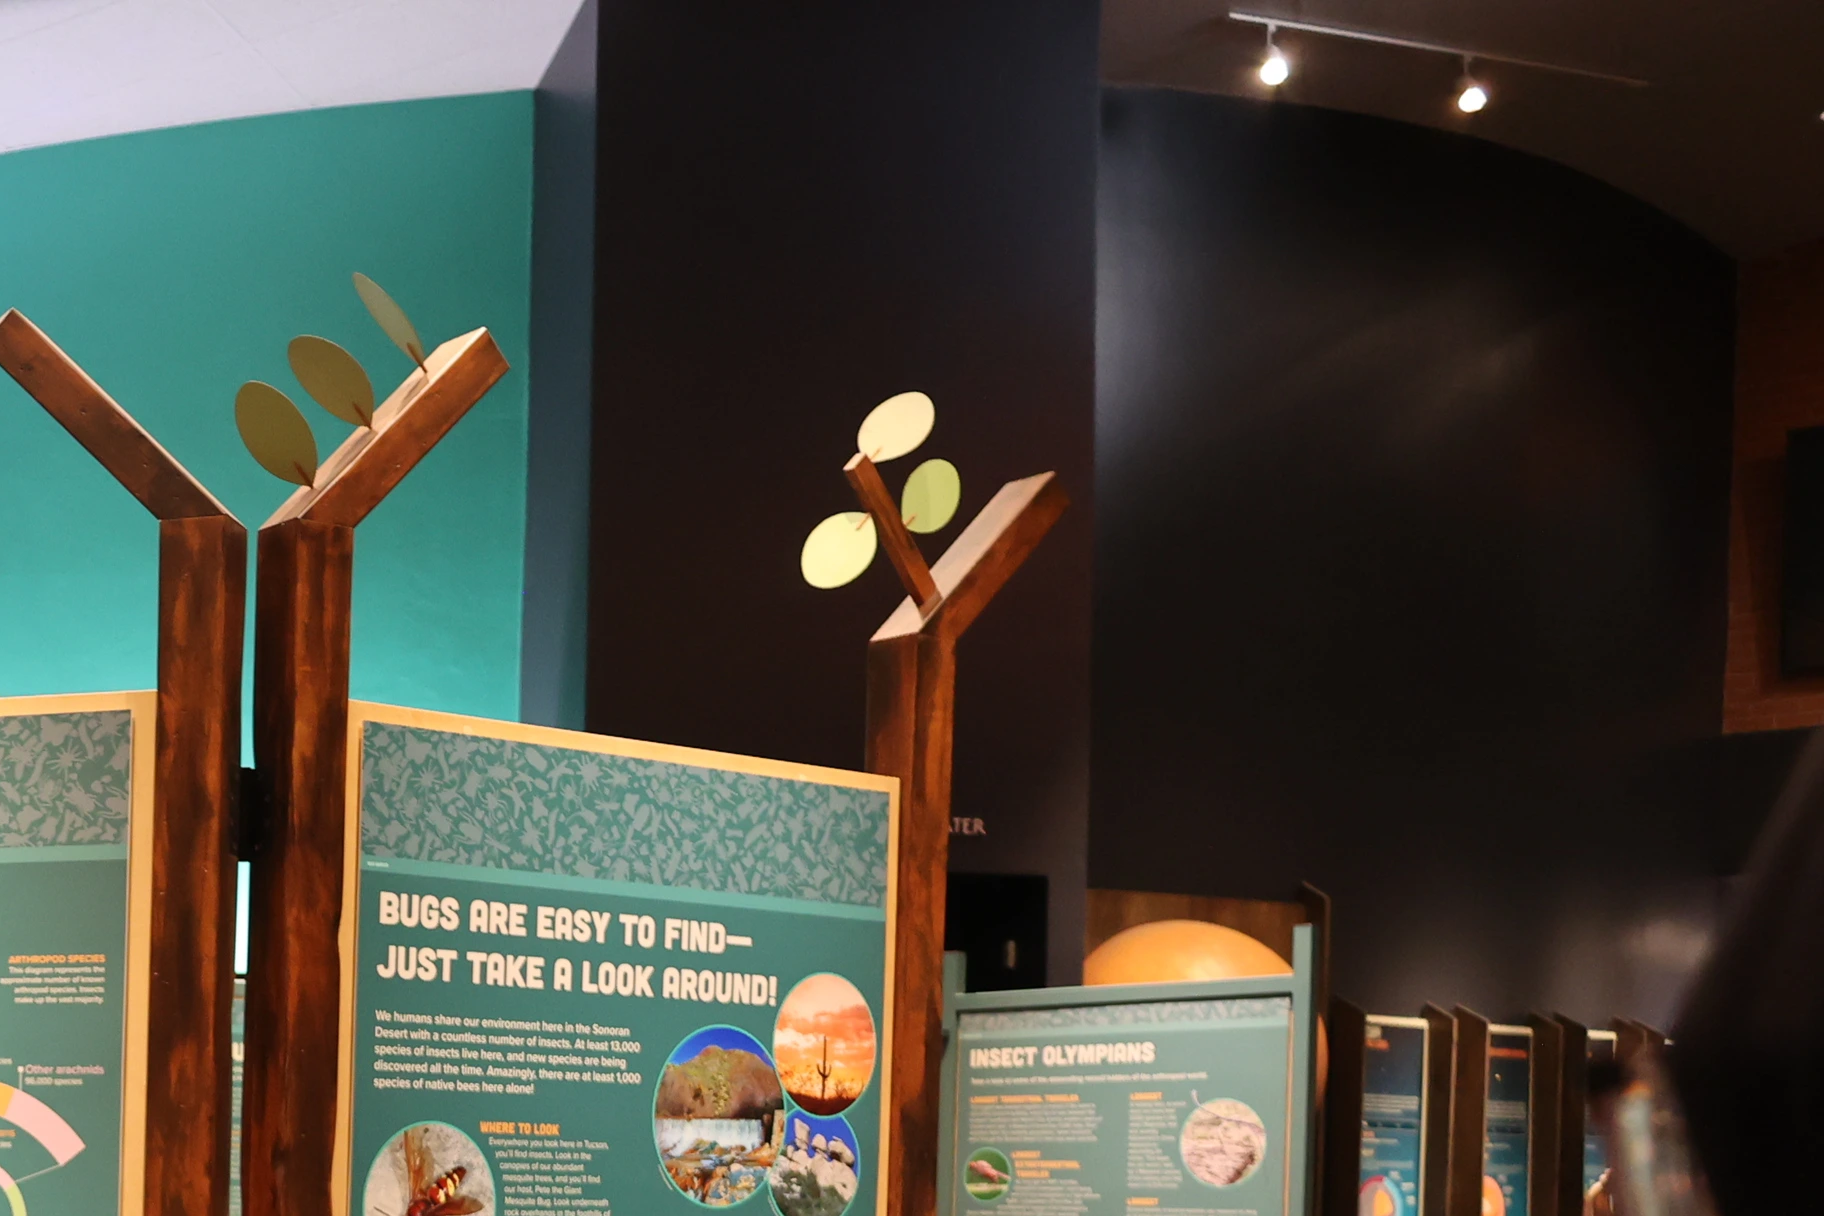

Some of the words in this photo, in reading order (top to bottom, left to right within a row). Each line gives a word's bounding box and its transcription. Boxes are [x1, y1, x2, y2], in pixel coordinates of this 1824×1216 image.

[949, 817, 986, 835] TER
[379, 890, 459, 931] BUGS
[470, 902, 526, 937] ARE
[537, 906, 611, 945] EASY
[620, 914, 655, 948] TO
[68, 954, 106, 963] SPECIES
[377, 945, 459, 983] JUST
[466, 951, 544, 990] TAKE
[553, 959, 573, 992] A
[582, 961, 654, 999] LOOK
[663, 968, 777, 1007] AROUND!
[376, 1010, 391, 1022] We
[394, 1011, 432, 1024] humans
[435, 1014, 461, 1026] share
[464, 1018, 479, 1027] our
[482, 1018, 540, 1031] environment
[542, 1020, 562, 1033] here
[565, 1022, 573, 1033] in
[576, 1023, 590, 1034] the
[593, 1024, 629, 1037] Sonoran
[375, 1026, 407, 1039] Desert
[410, 1028, 430, 1040] with
[433, 1032, 438, 1041] a
[441, 1031, 486, 1044] countless
[489, 1034, 524, 1046] number
[527, 1035, 536, 1047] of
[574, 1038, 585, 1050] At
[587, 1039, 608, 1051] least
[374, 1044, 412, 1057] species
[414, 1045, 424, 1056] of
[426, 1045, 459, 1058] insects
[462, 1047, 478, 1059] live
[507, 1051, 524, 1062] and
[526, 1054, 546, 1063] new
[548, 1053, 582, 1067] species
[584, 1057, 599, 1066] are
[601, 1055, 626, 1071] being
[969, 1047, 1038, 1069] INSECT
[1042, 1041, 1156, 1066] OLYMPIANS
[374, 1059, 427, 1073] discovered
[430, 1062, 441, 1073] all
[443, 1062, 459, 1074] the
[539, 1068, 563, 1080] there
[565, 1072, 579, 1081] are
[582, 1070, 590, 1081] at
[592, 1071, 614, 1083] least
[374, 1077, 410, 1091] species
[413, 1078, 423, 1089] of
[425, 1079, 454, 1091] native
[457, 1080, 480, 1092] bees
[482, 1081, 503, 1093] here
[506, 1082, 534, 1094] alone!
[480, 1121, 515, 1134] WHERE
[518, 1122, 532, 1135] TO
[534, 1123, 560, 1136] LOOK
